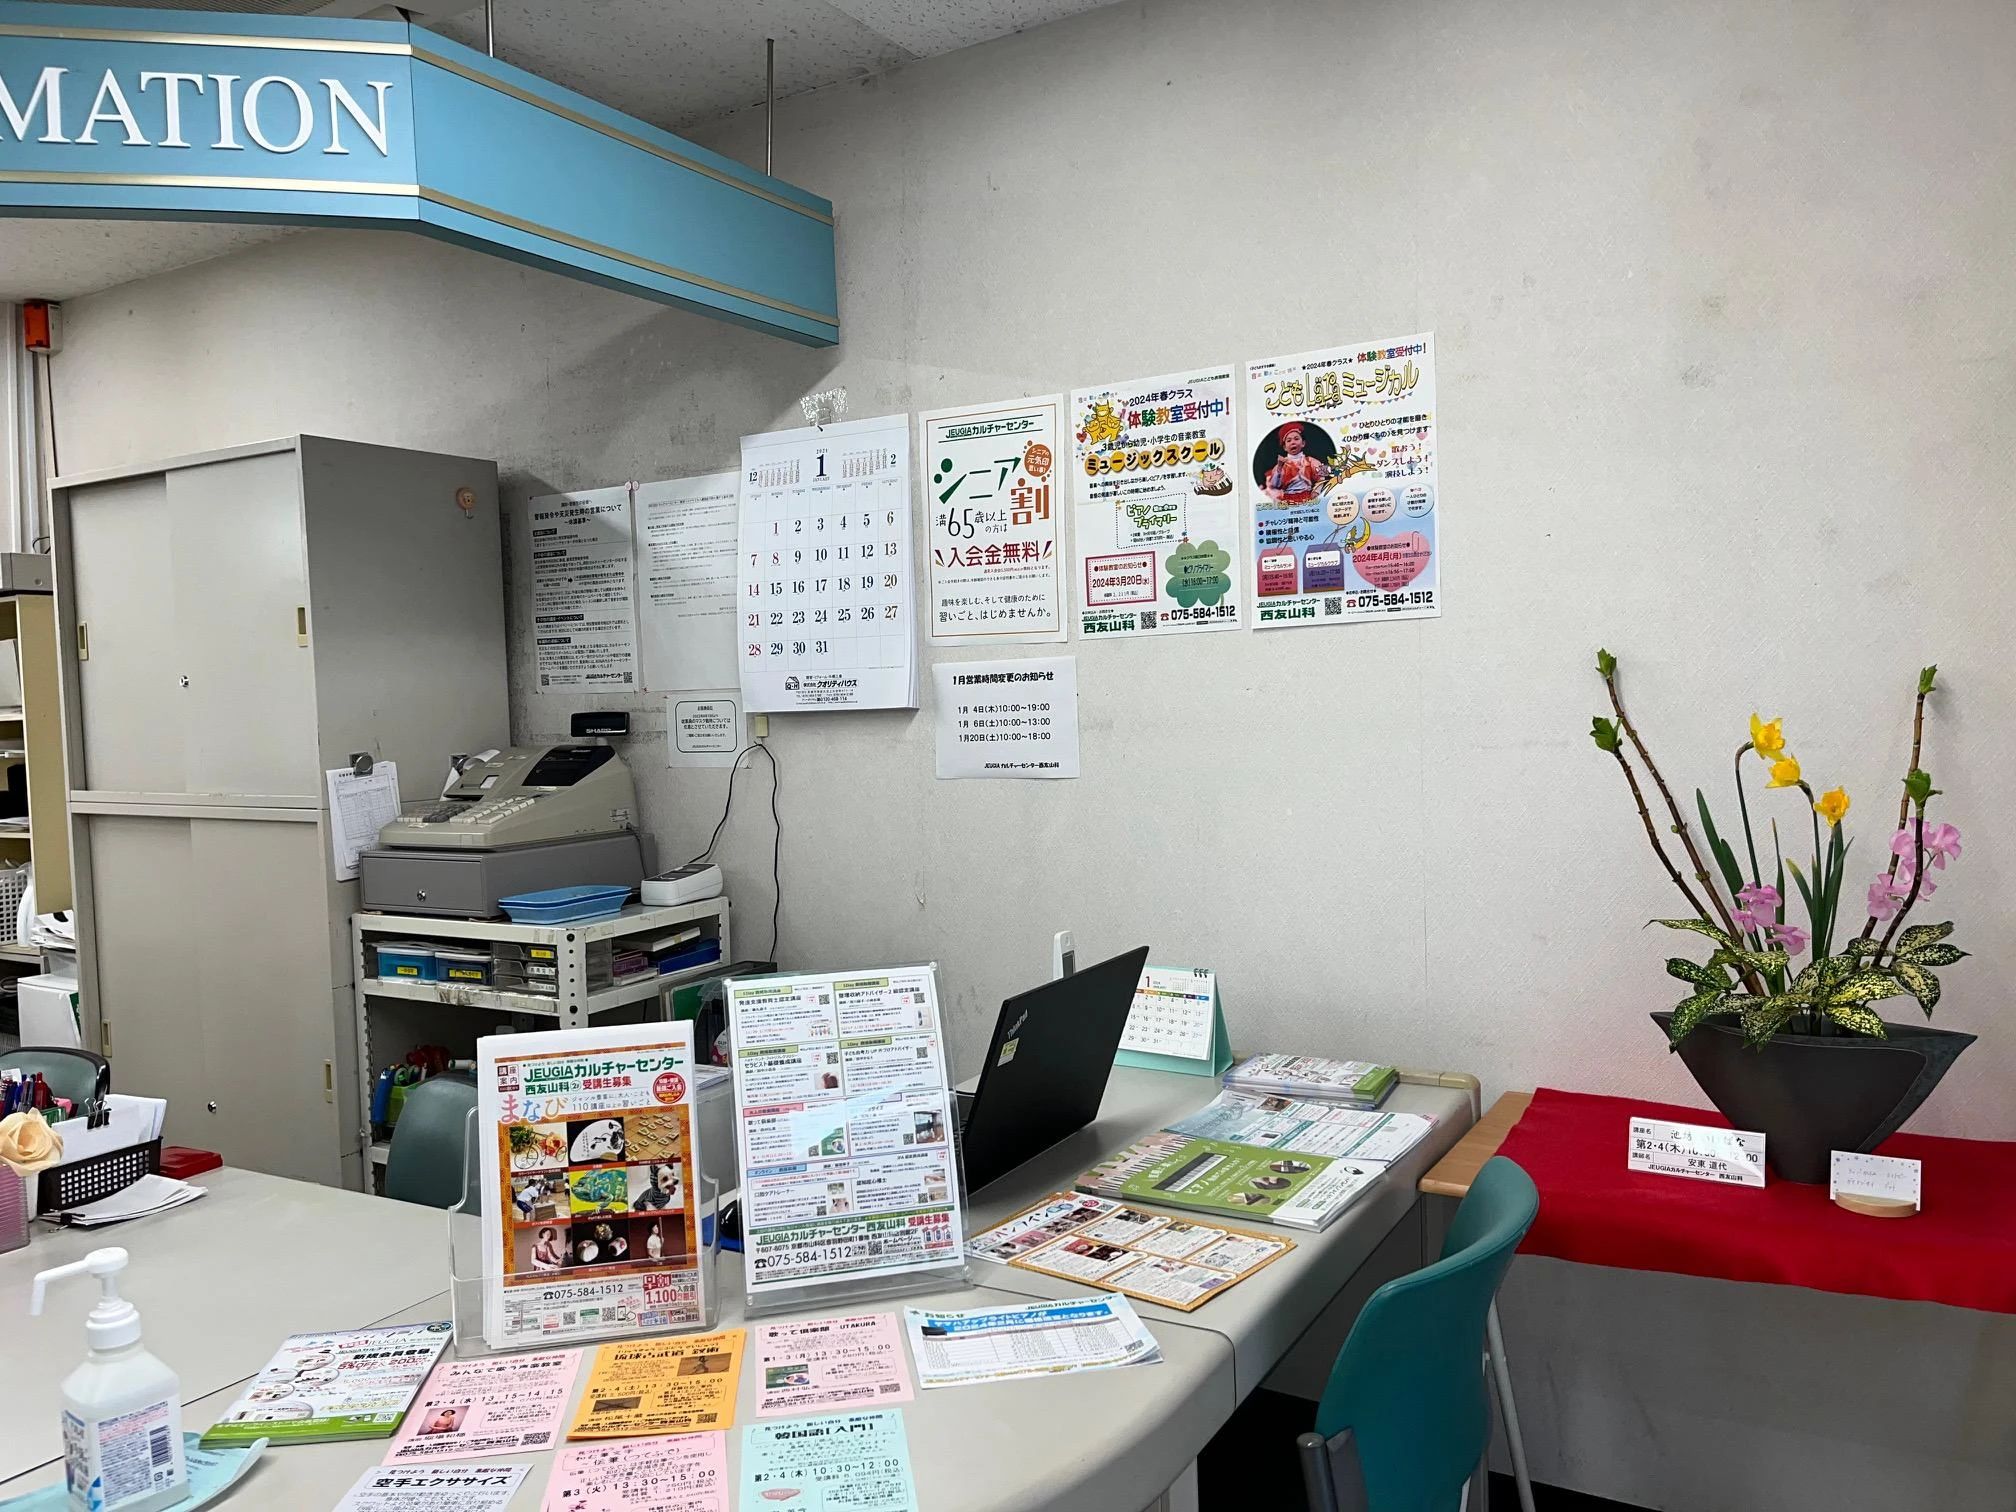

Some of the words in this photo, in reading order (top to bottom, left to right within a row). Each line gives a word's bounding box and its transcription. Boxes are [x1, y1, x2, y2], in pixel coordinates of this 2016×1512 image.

[0, 67, 393, 158] MATION
[1357, 343, 1427, 364] 体験教室受付中!
[1129, 388, 1193, 407] 2024年春クラス
[1128, 396, 1231, 430] 体験教室受付中!
[945, 419, 1035, 439] JEUGIAカルチャーセンター
[1086, 442, 1221, 473] ミュージックスクール
[749, 471, 758, 482] 12
[816, 454, 828, 477] 1
[890, 453, 897, 465] 2
[1126, 504, 1151, 516] ピアノ
[774, 523, 779, 535] 1
[795, 520, 802, 533] 2
[817, 518, 824, 531] 3
[840, 516, 847, 528] 4
[863, 514, 870, 527] 5
[887, 512, 894, 524] 6
[985, 523, 1008, 534] の方は
[751, 554, 757, 567] 7
[772, 552, 779, 565] 8
[795, 551, 801, 563] 9
[816, 549, 828, 562] 10
[838, 547, 849, 560] 11
[861, 545, 874, 558] 12
[884, 543, 897, 556] 13
[947, 540, 1040, 568] 入会金無料
[748, 584, 760, 597] 14
[770, 583, 783, 595] 15
[792, 581, 805, 594] 16
[815, 579, 828, 592] 17
[838, 577, 851, 591] 18
[861, 576, 874, 589] 19
[884, 574, 898, 588] 20
[941, 594, 1046, 607] 趣味を楽しむ、そして健康のために
[1358, 591, 1433, 608] 075-584-1512
[748, 614, 761, 627] 21
[770, 613, 783, 625] 22
[792, 612, 805, 624] 23
[815, 610, 828, 623] 24
[838, 609, 851, 622] 25
[861, 607, 875, 620] 26
[884, 606, 898, 619] 27
[939, 607, 1051, 623] 習いごと、はじめませんか。
[1171, 605, 1236, 621] 075-584-1512
[1260, 607, 1315, 621] 西友山科
[1083, 620, 1135, 634] 西友山科
[748, 644, 761, 657] 28
[770, 643, 783, 656] 29
[792, 642, 806, 655] 30
[815, 640, 828, 653] 31
[952, 671, 1055, 686] 1月営業時間変更のお知らせ
[957, 706, 968, 715] 1月
[973, 703, 1050, 714] 4日(木)10:00~19:00
[958, 720, 969, 729] 1月
[973, 717, 1051, 729] 6日(土)10:00~13:00
[958, 732, 1051, 743] 1月20日(土)10:00~18:00
[1145, 976, 1150, 987] 1
[524, 1057, 684, 1083] JEUGIAカルチャーセンター
[525, 1081, 570, 1096] 西友山科
[582, 1075, 632, 1090] 受講生募集
[501, 1094, 568, 1124] まなび
[1633, 1126, 1652, 1135] 講座名
[1632, 1151, 1651, 1160] 講師名
[1688, 1158, 1706, 1168] 安東
[1709, 1161, 1728, 1170] 道代
[1647, 1164, 1715, 1177] JEUGIAカルチャーセンター
[1718, 1173, 1743, 1182] 西友山科
[908, 1213, 950, 1228] 受講生募集
[767, 1246, 851, 1268] 075-584-1512
[644, 1273, 671, 1290] 早割
[677, 1284, 696, 1292] 入会金
[554, 1283, 624, 1300] 075-584-1512
[768, 1325, 830, 1338] 歌って倶楽部
[839, 1320, 876, 1331] UTAKURA
[450, 1360, 563, 1377] みんなで歌う声楽教室
[372, 1475, 510, 1489] 空手エクササイズ
